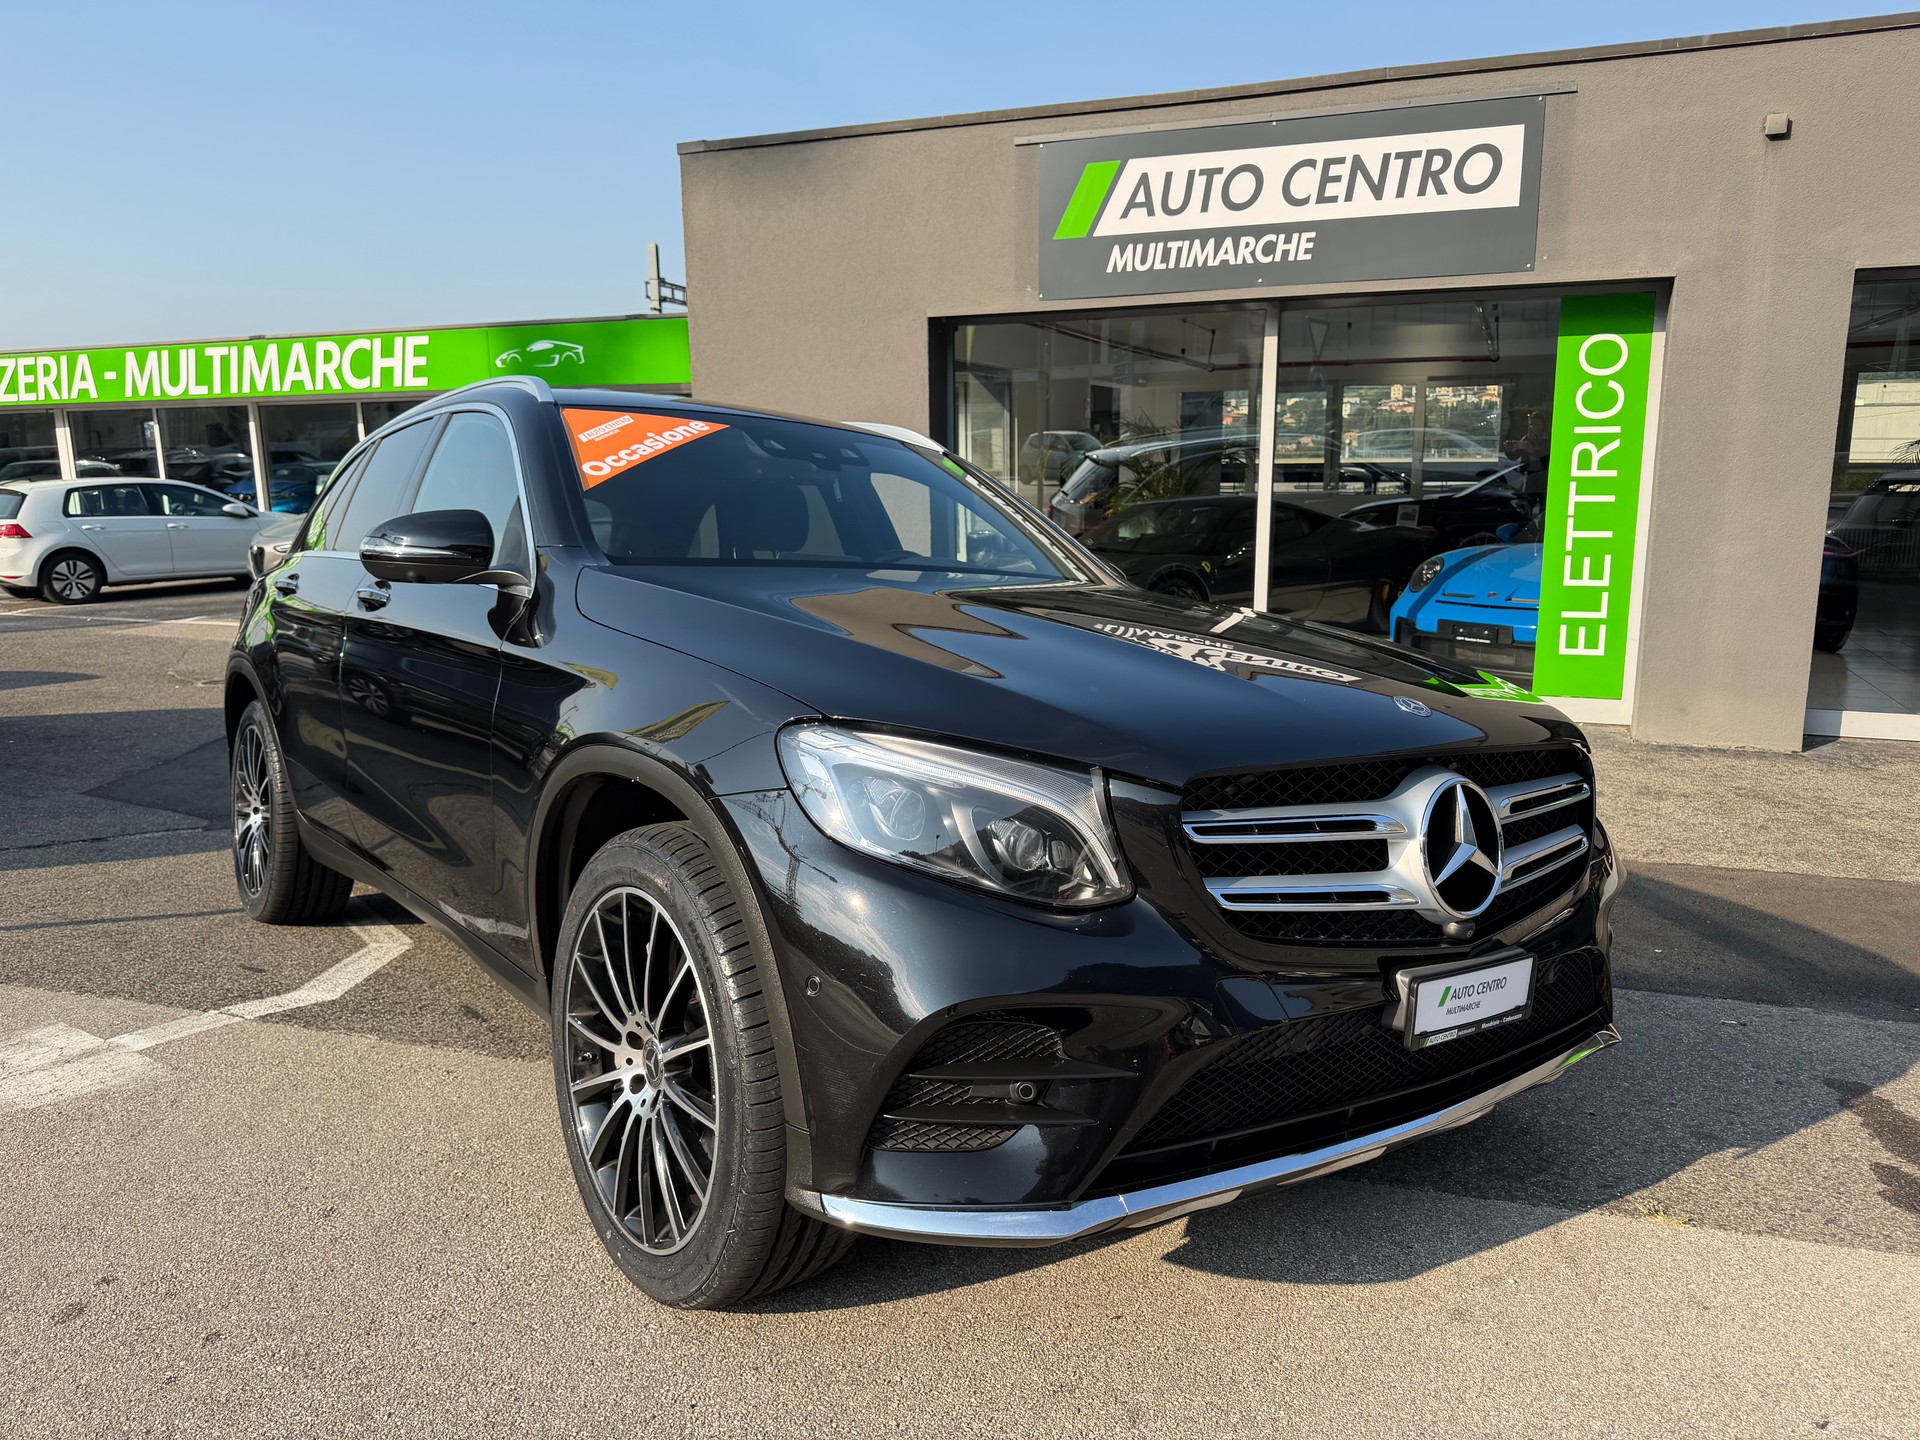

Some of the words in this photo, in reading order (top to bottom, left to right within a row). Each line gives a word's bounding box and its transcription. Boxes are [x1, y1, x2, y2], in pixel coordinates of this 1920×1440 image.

[1119, 163, 1264, 220] AUTO
[1281, 142, 1503, 207] CENTRO
[1106, 231, 1316, 274] MULTIMARCHE
[0, 354, 99, 402] ZERIA
[124, 335, 429, 398] MULTIMARCHE
[581, 420, 711, 476] Occasione
[1558, 333, 1629, 656] ELETTRICO
[1445, 1000, 1482, 1016] MULTIMARCHE
[1451, 984, 1475, 1001] AUTO
[1476, 976, 1508, 995] CENTRO
